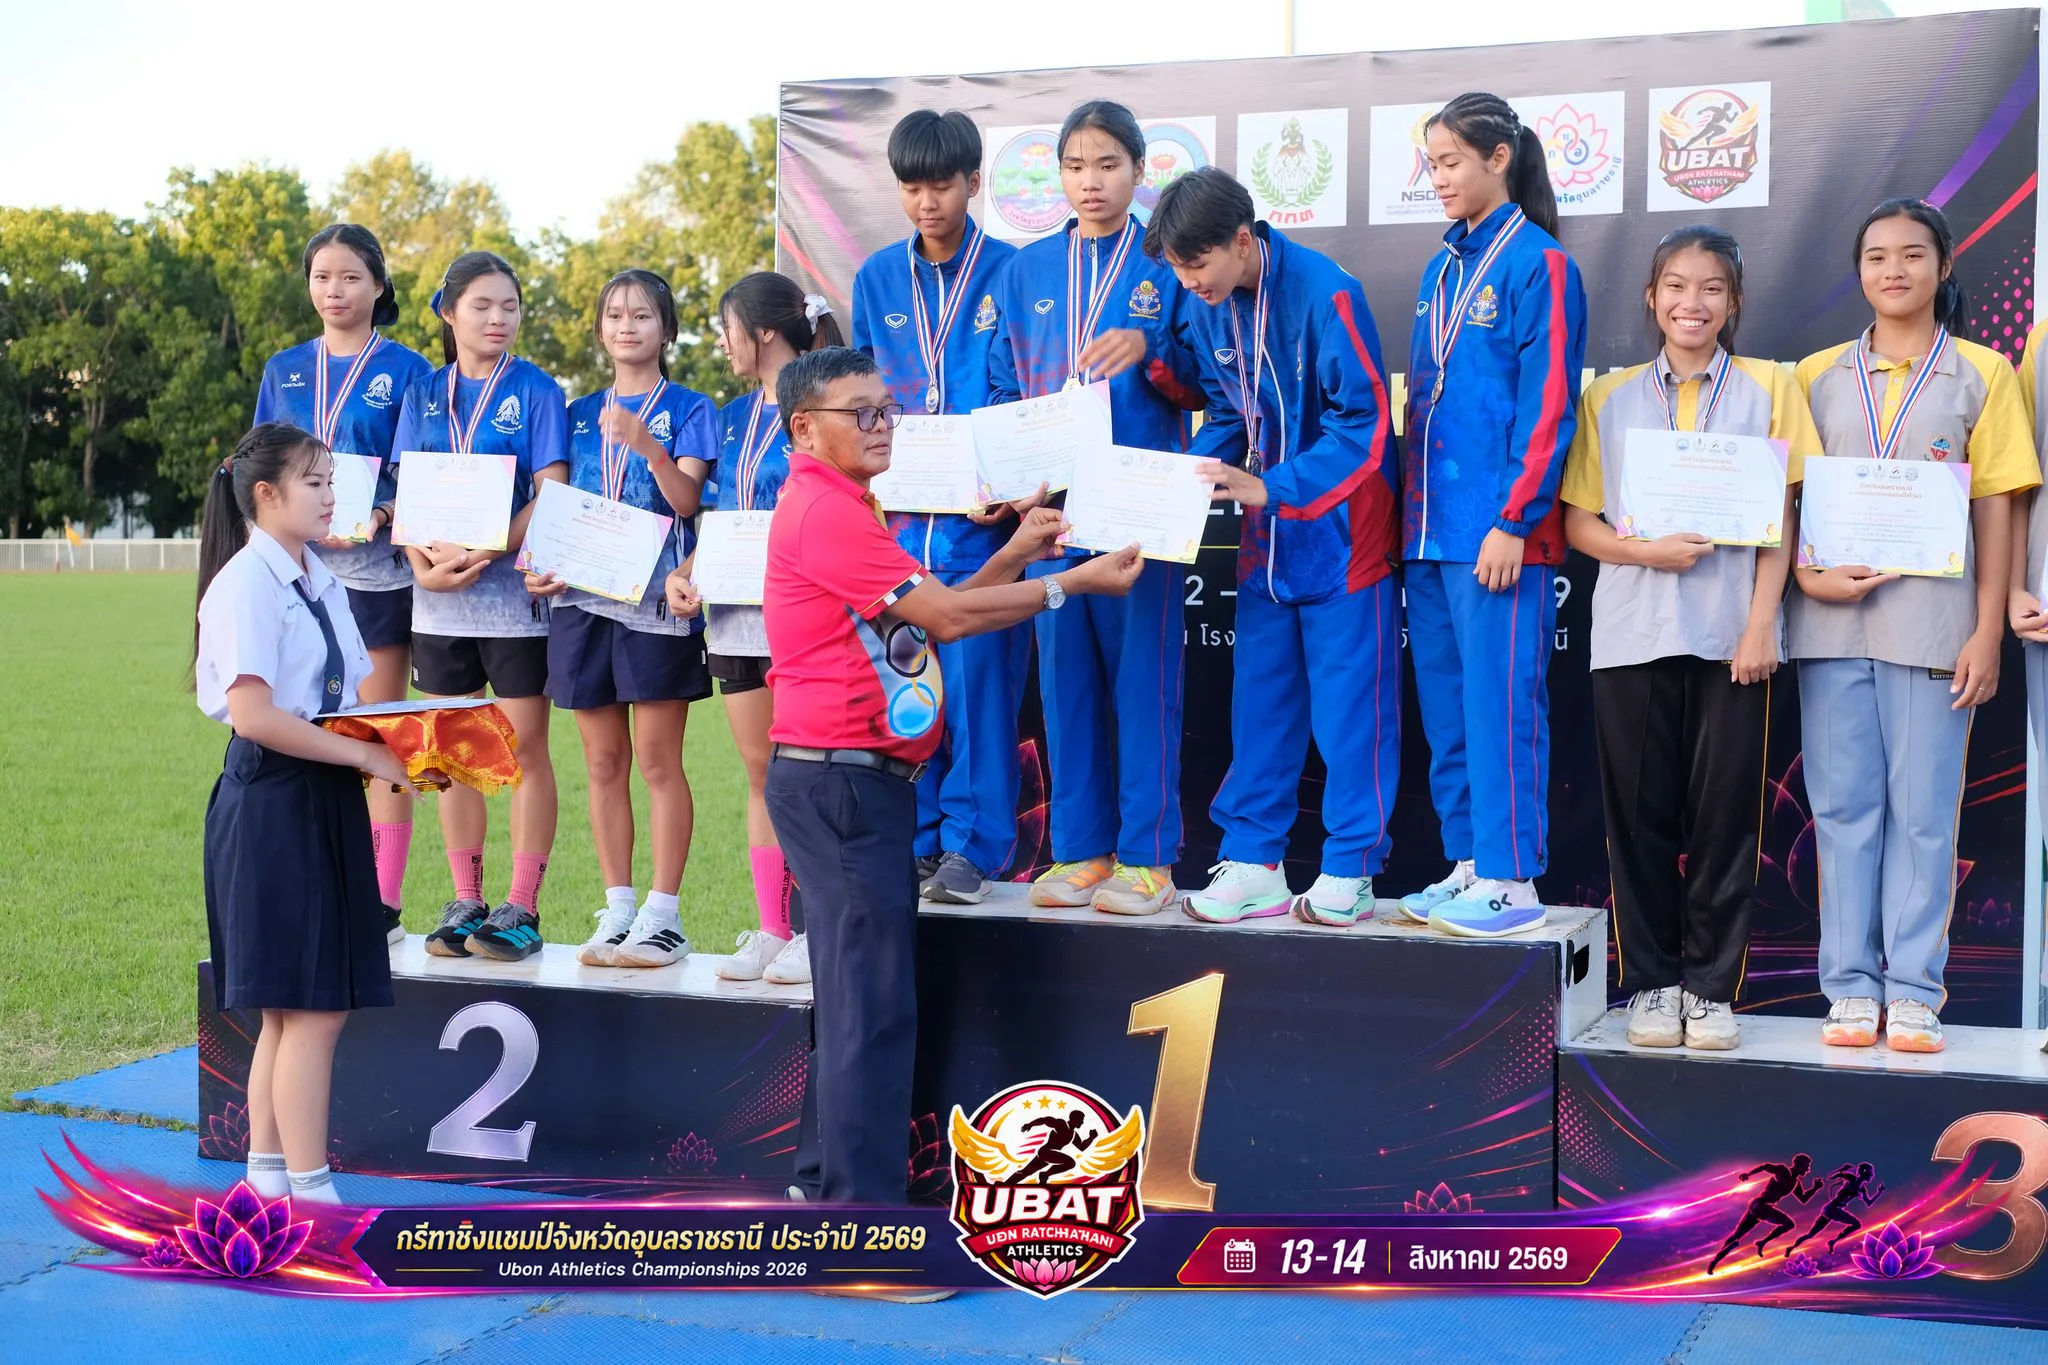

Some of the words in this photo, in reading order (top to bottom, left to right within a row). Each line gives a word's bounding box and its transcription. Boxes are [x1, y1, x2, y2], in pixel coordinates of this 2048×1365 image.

[1667, 146, 1750, 172] UBAT
[1687, 178, 1728, 186] ATHLETICS
[427, 1001, 540, 1162] 2
[1127, 973, 1224, 1212] 1
[1931, 1111, 2048, 1281] 3
